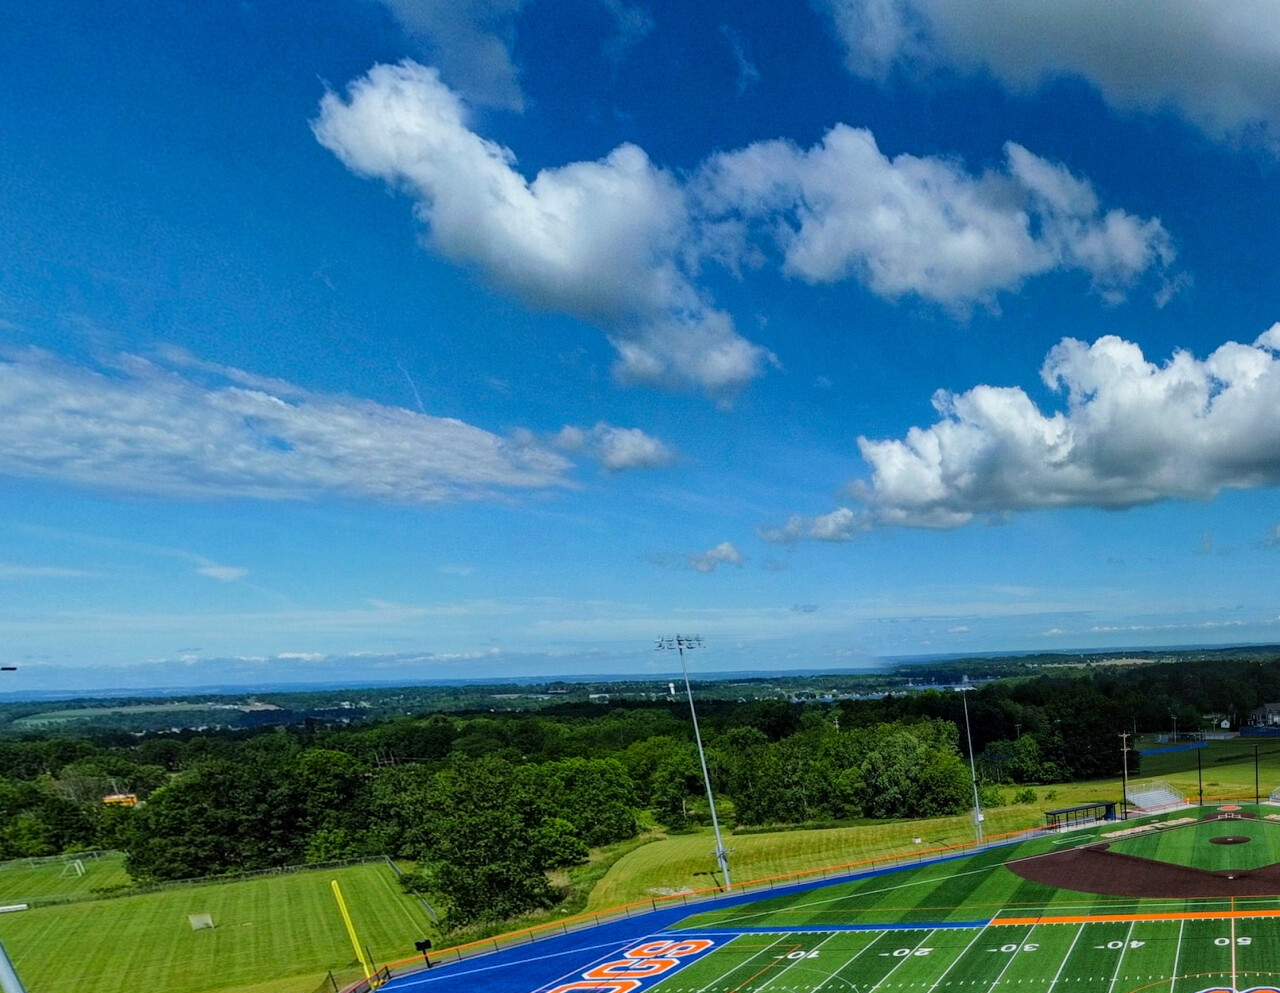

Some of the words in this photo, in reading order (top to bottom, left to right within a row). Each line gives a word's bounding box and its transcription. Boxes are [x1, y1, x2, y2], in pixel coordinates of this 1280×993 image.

[1107, 940, 1145, 949] 40
[1214, 937, 1252, 946] 50
[1001, 943, 1040, 952] 30
[787, 950, 820, 959] 10
[893, 948, 934, 957] 20
